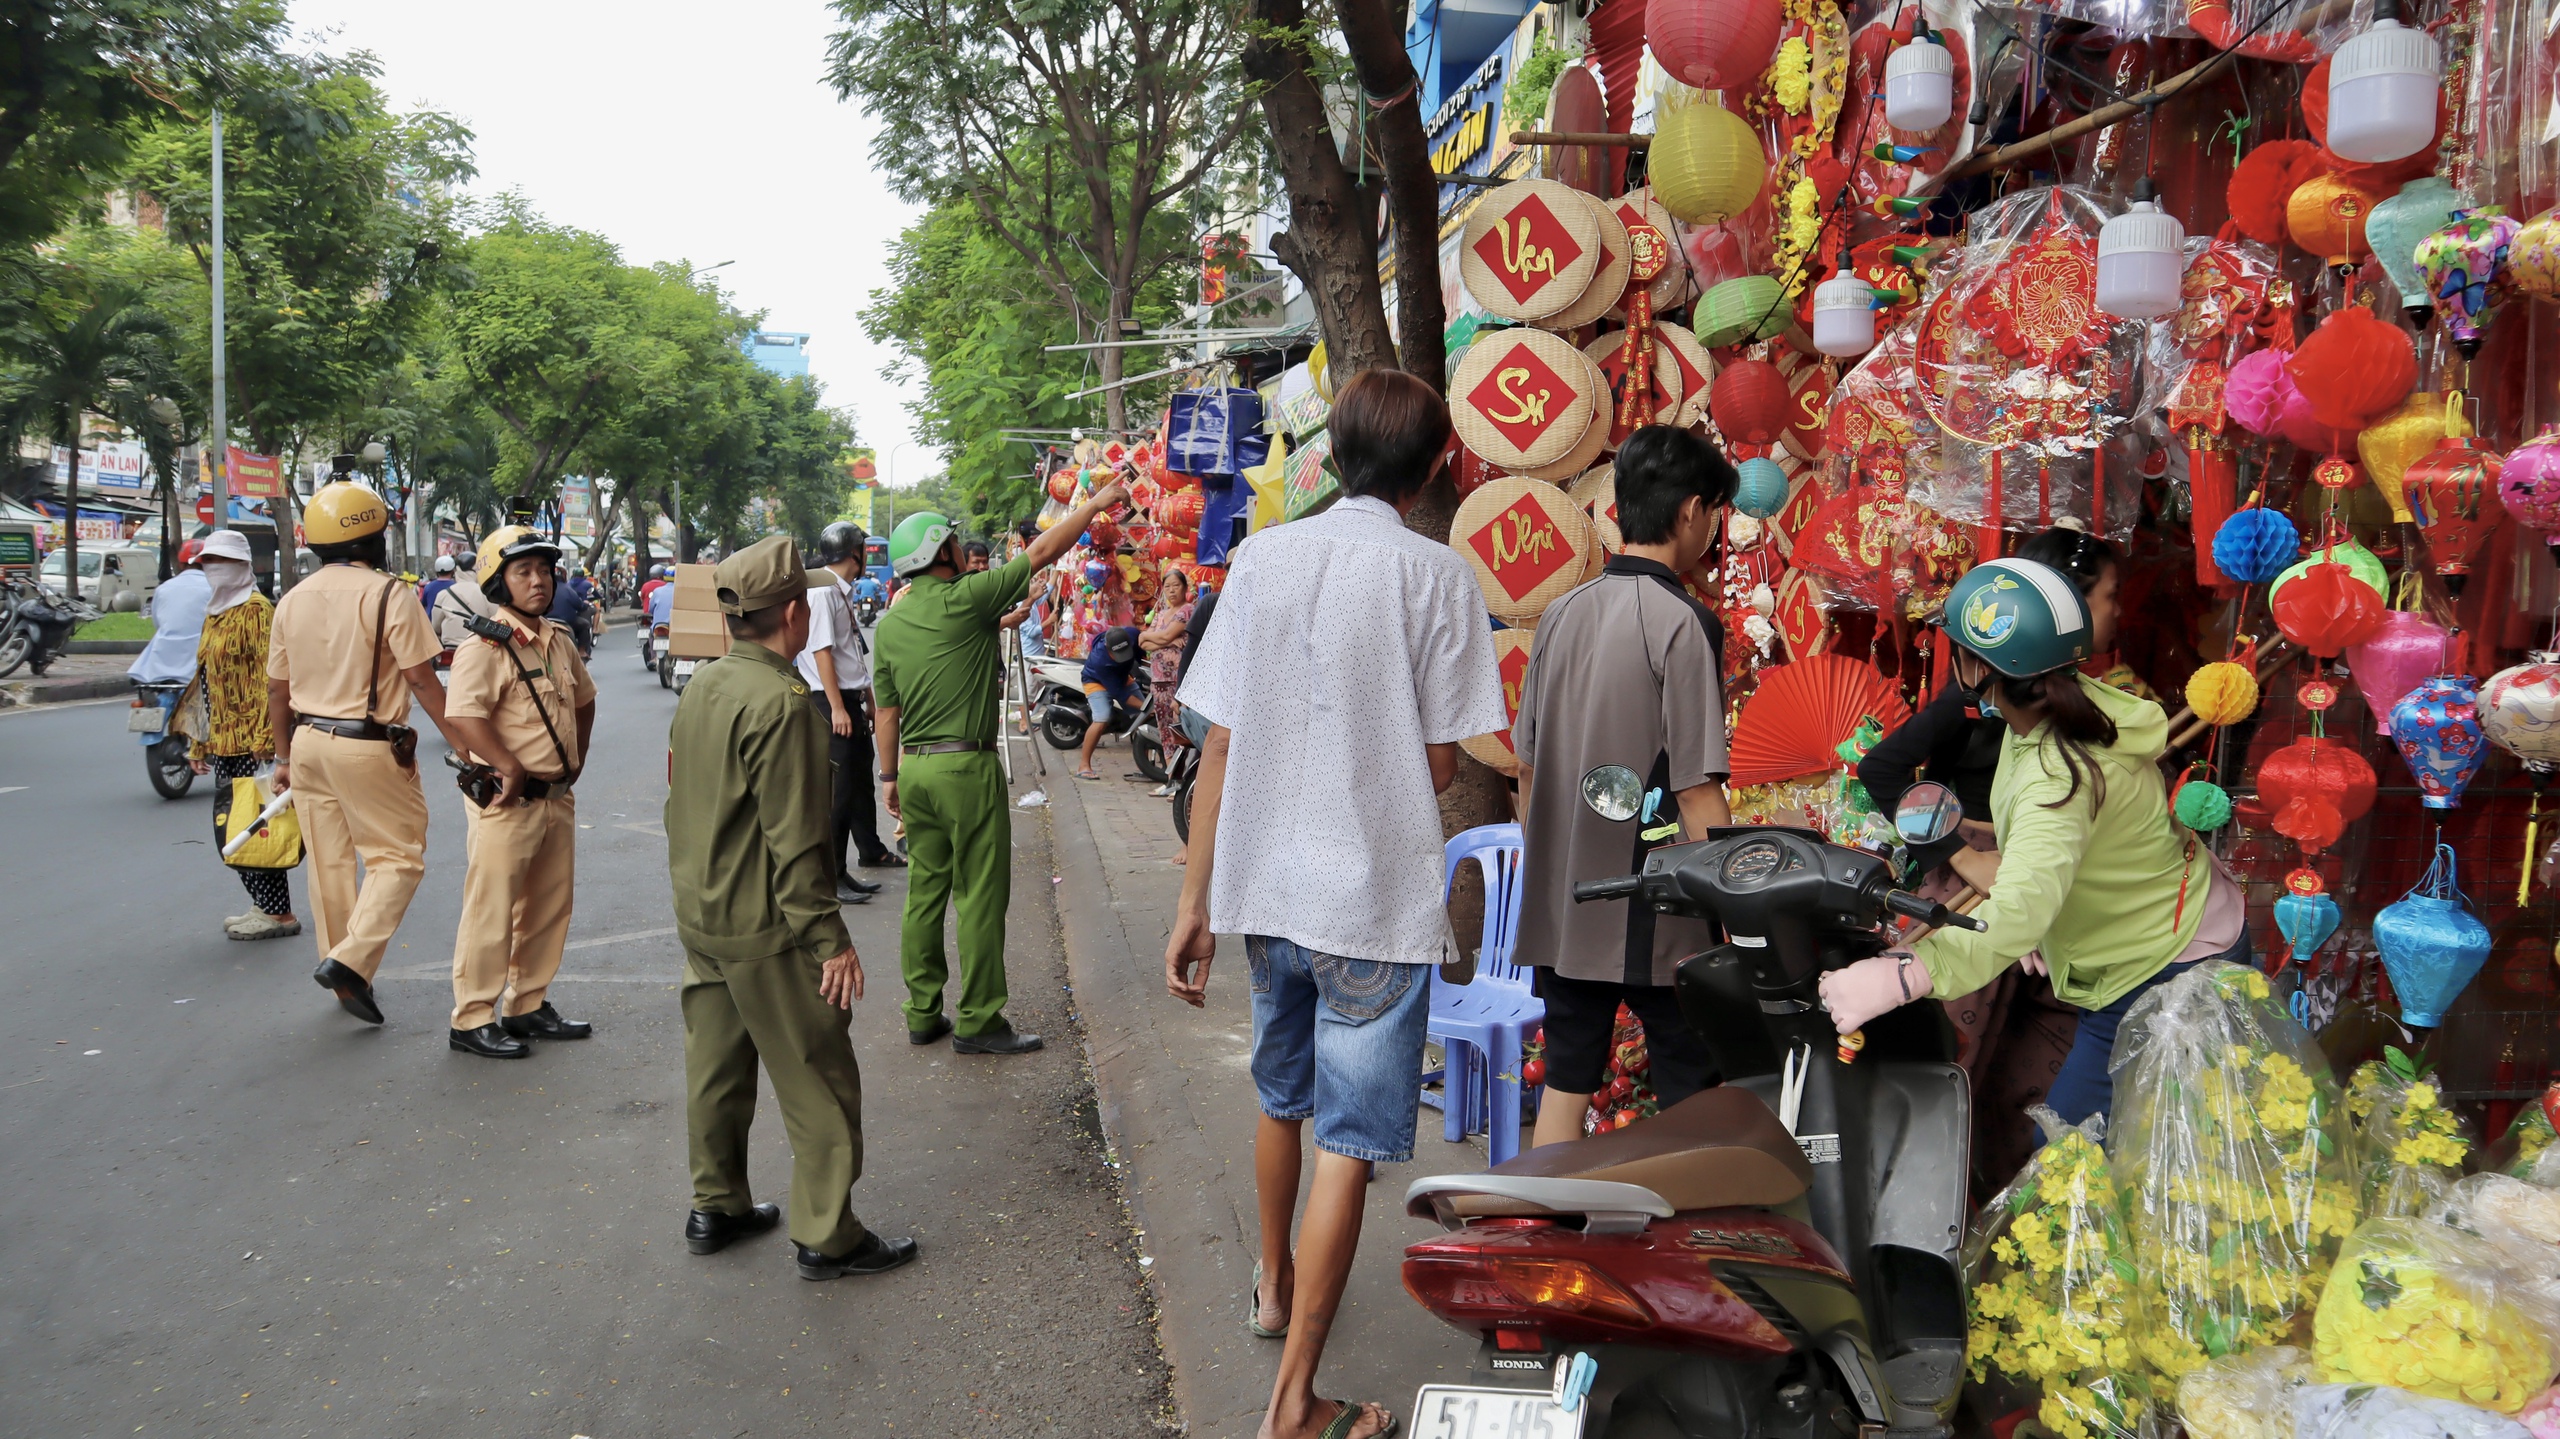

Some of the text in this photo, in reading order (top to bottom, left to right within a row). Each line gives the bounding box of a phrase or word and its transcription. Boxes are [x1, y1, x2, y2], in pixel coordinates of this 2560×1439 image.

[1449, 85, 1467, 117] 210
[1476, 54, 1499, 90] 212
[118, 456, 138, 472] LAN
[340, 508, 377, 528] CSGT
[1931, 532, 1967, 560] Lộc
[1493, 1359, 1545, 1370] HONDA
